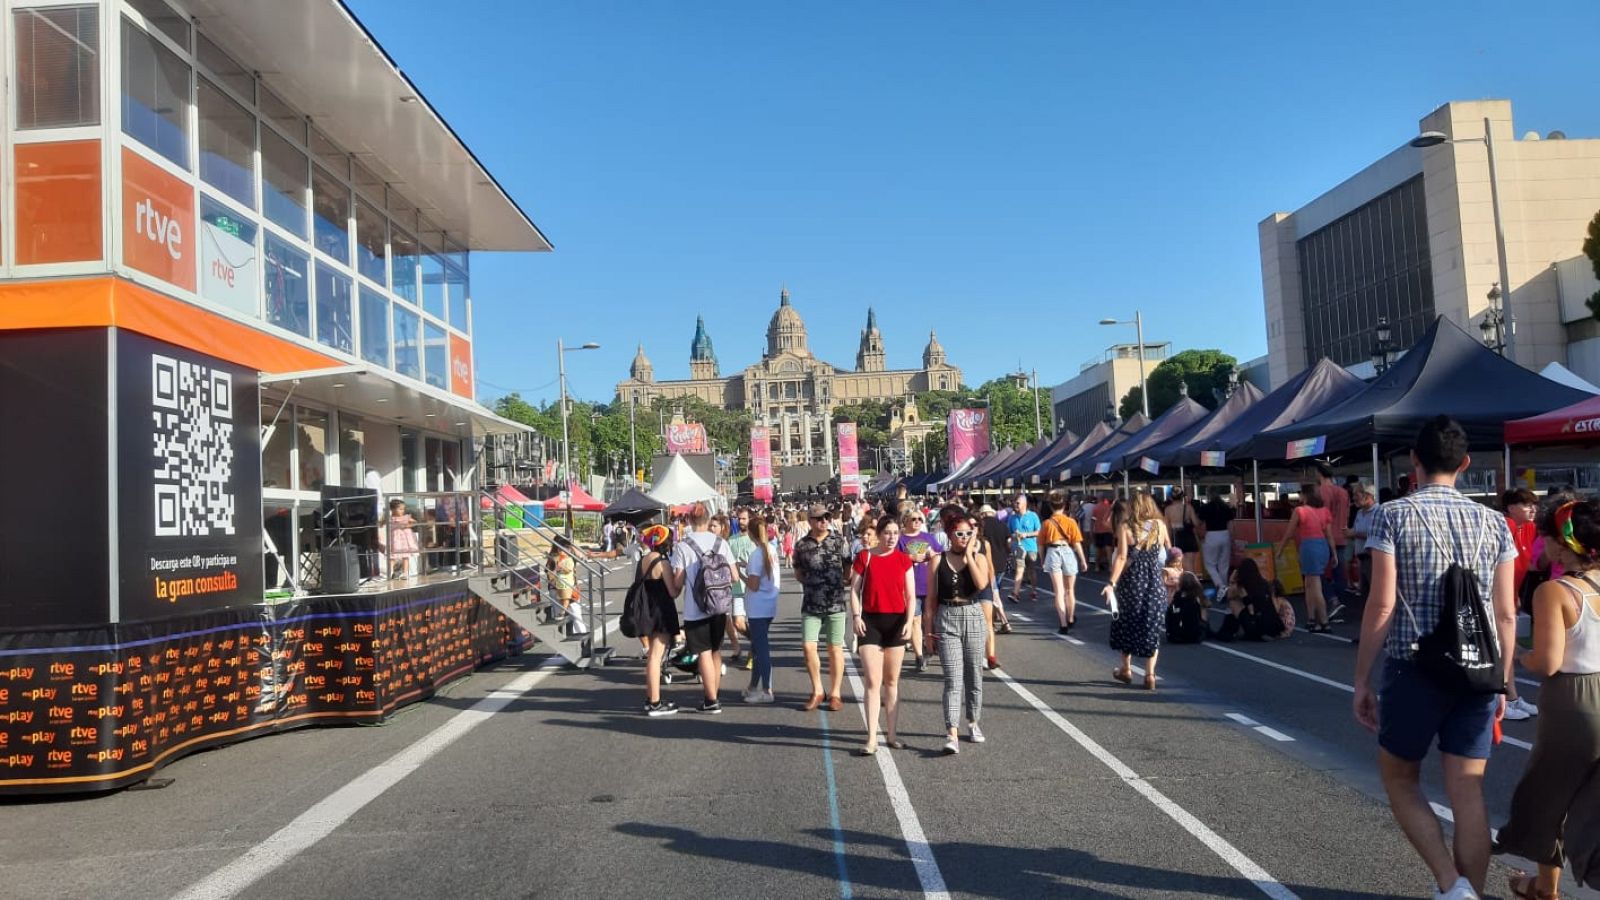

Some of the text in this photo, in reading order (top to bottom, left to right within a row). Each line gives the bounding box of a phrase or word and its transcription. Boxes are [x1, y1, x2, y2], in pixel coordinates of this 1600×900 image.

[136, 198, 182, 260] rtve
[212, 258, 235, 289] rtve
[151, 554, 237, 571] Descarga este QR y participa en
[156, 570, 237, 602] la gran consulta
[284, 629, 305, 640] rtve
[323, 627, 341, 637] play
[355, 623, 373, 633] rtve
[303, 643, 323, 652] rtve
[341, 642, 361, 653] play
[325, 660, 342, 670] play
[356, 656, 374, 667] rtve
[10, 667, 34, 681] play
[51, 662, 75, 675] rtve
[99, 662, 124, 676] play
[304, 675, 325, 686] rtve
[343, 676, 362, 687] play
[33, 688, 57, 701] play
[72, 683, 98, 696] rtve
[357, 691, 375, 700] rtve
[288, 693, 308, 704] rtve
[327, 693, 345, 703] play
[10, 711, 34, 724] play
[49, 706, 73, 719] rtve
[98, 705, 124, 719] play
[32, 731, 55, 744] play
[71, 726, 97, 739] rtve
[10, 754, 34, 768] play
[48, 750, 72, 763] rtve
[98, 748, 124, 762] play
